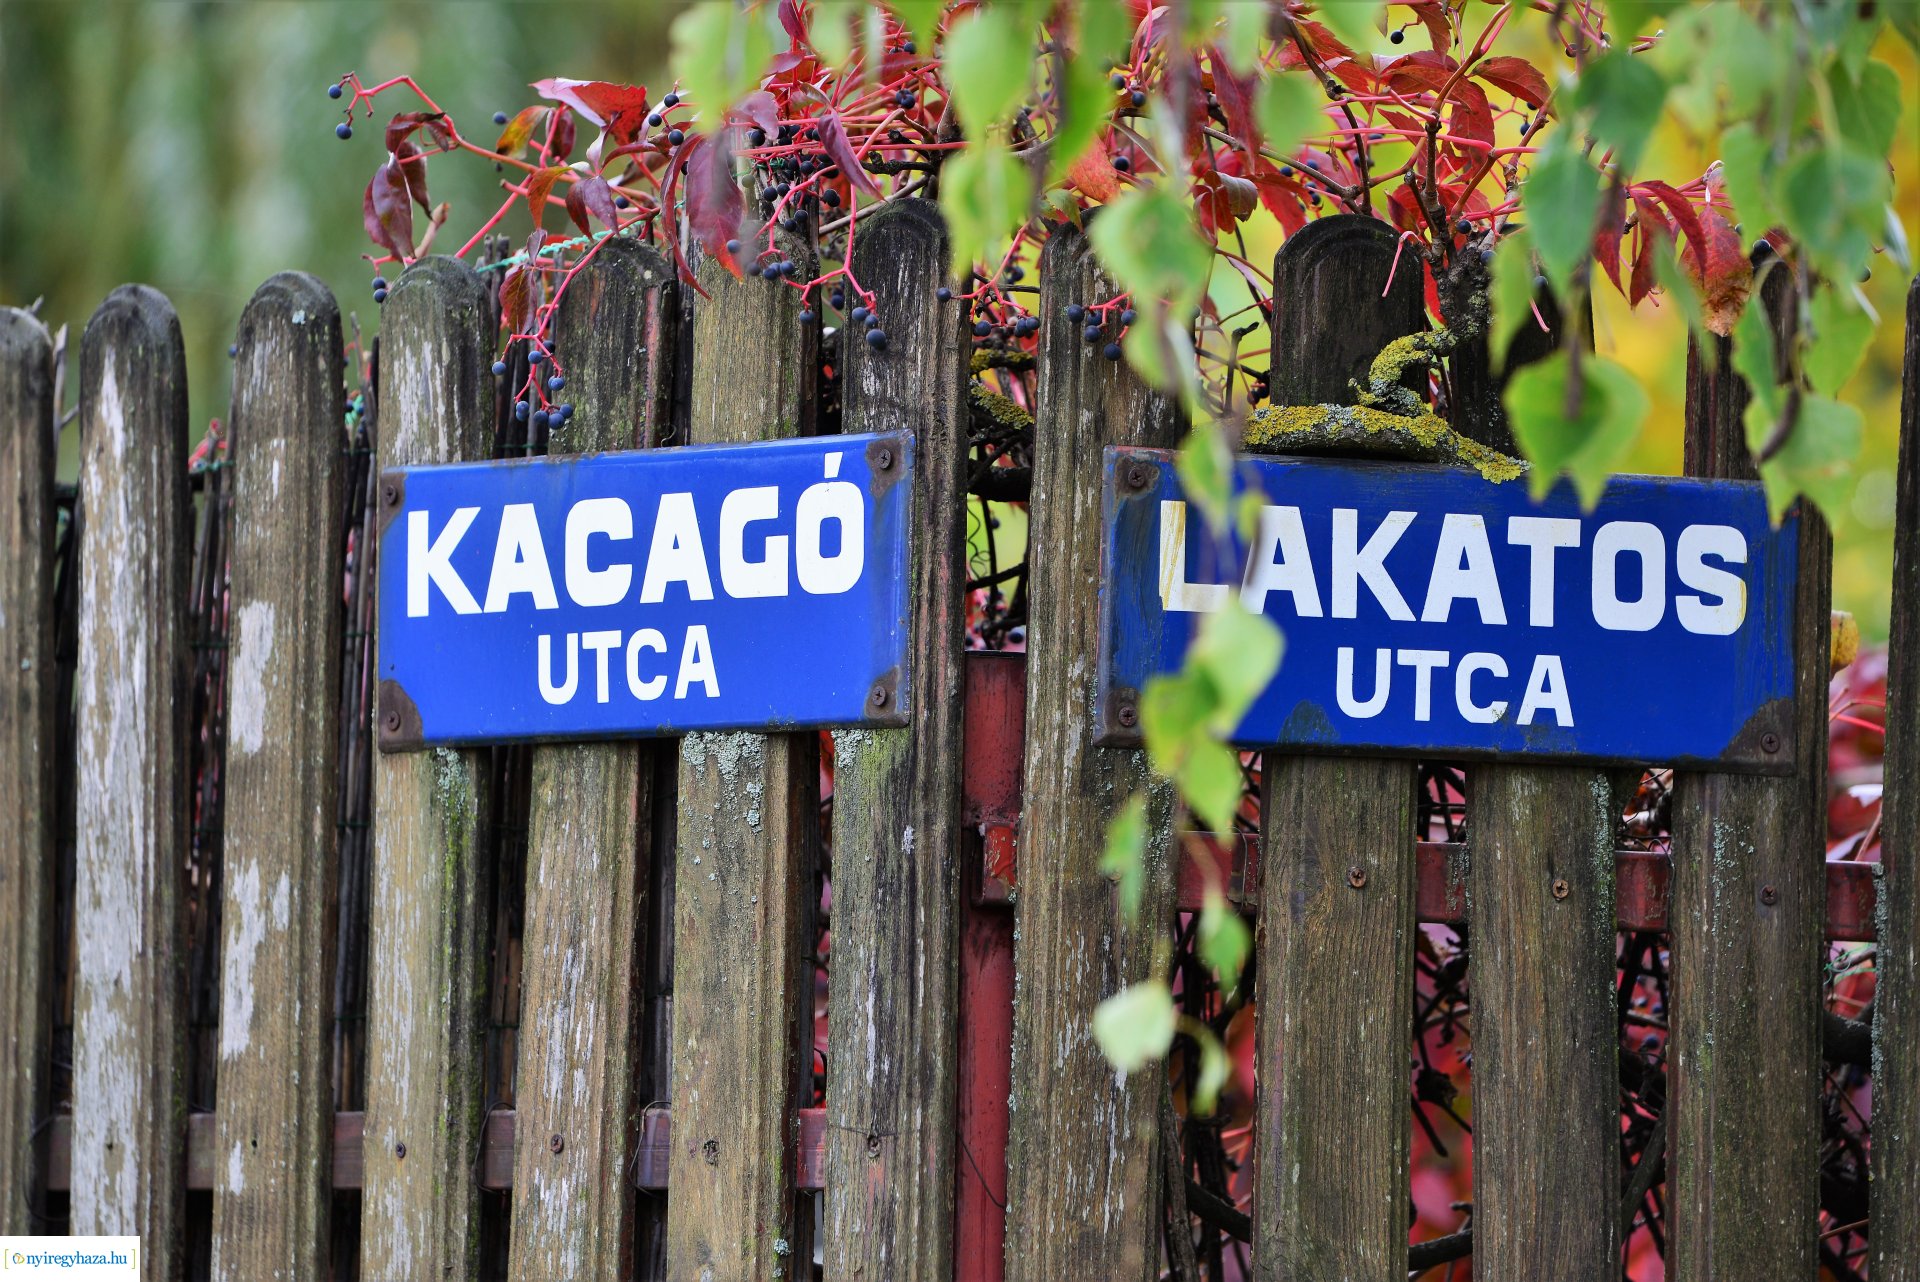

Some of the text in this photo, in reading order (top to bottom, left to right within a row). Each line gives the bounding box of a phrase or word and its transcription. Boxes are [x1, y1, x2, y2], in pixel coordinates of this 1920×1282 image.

[407, 452, 865, 618] KACAGÓ
[1158, 500, 1748, 636] LAKATOS
[537, 624, 721, 705] UTCA
[1336, 647, 1575, 727] UTCA
